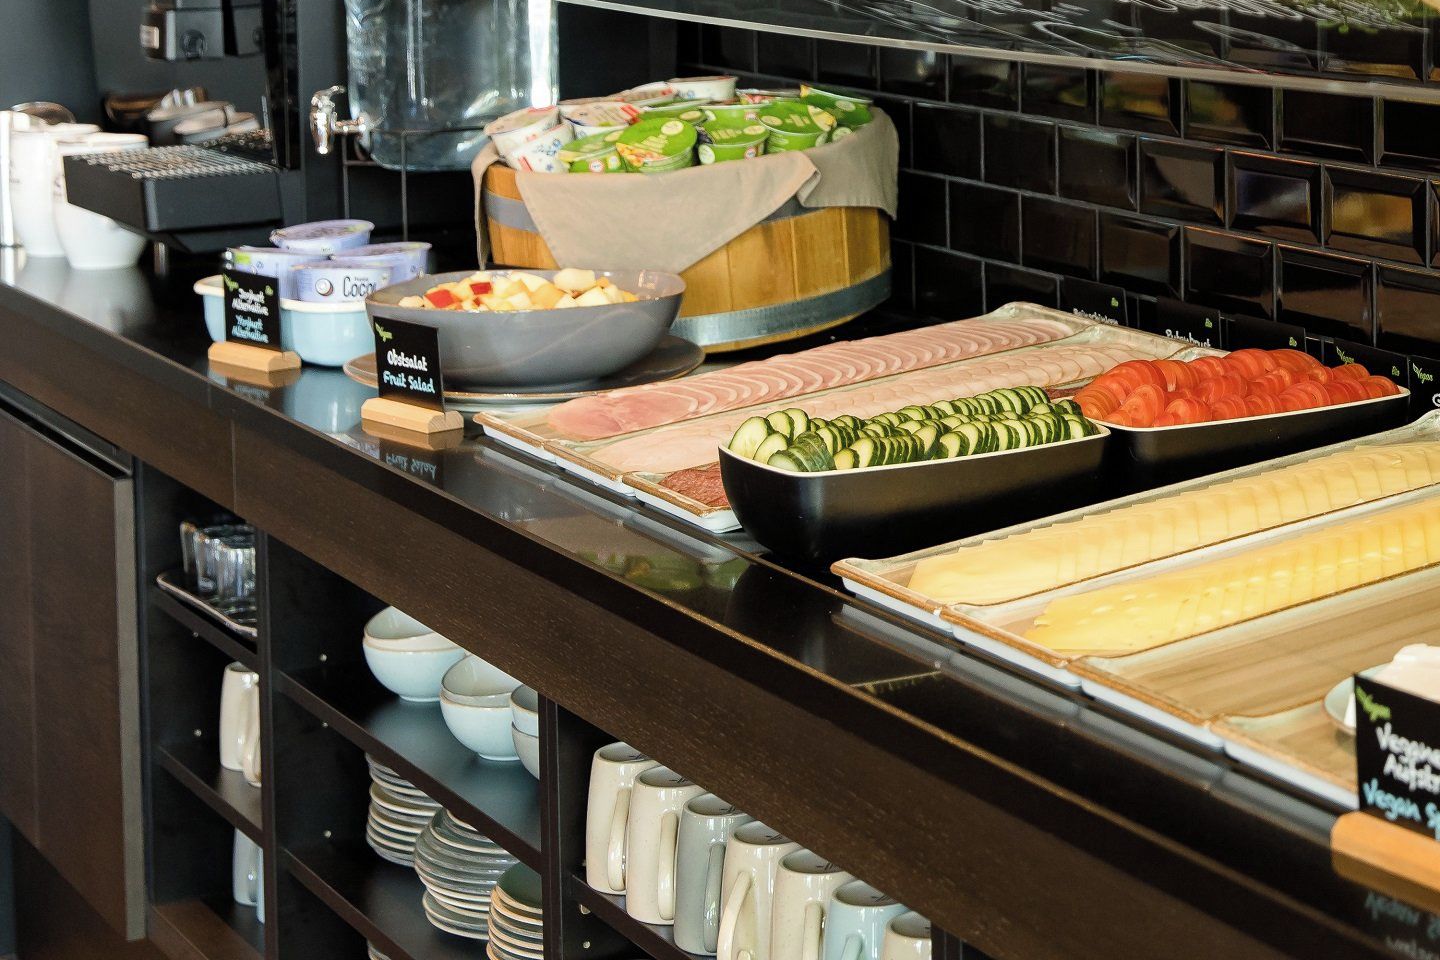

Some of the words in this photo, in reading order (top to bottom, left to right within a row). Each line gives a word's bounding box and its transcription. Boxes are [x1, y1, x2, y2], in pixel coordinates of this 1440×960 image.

[387, 348, 428, 371] Obstsalat
[383, 370, 406, 387] Fruit
[408, 375, 435, 394] Salad
[1363, 778, 1422, 821] Vegan
